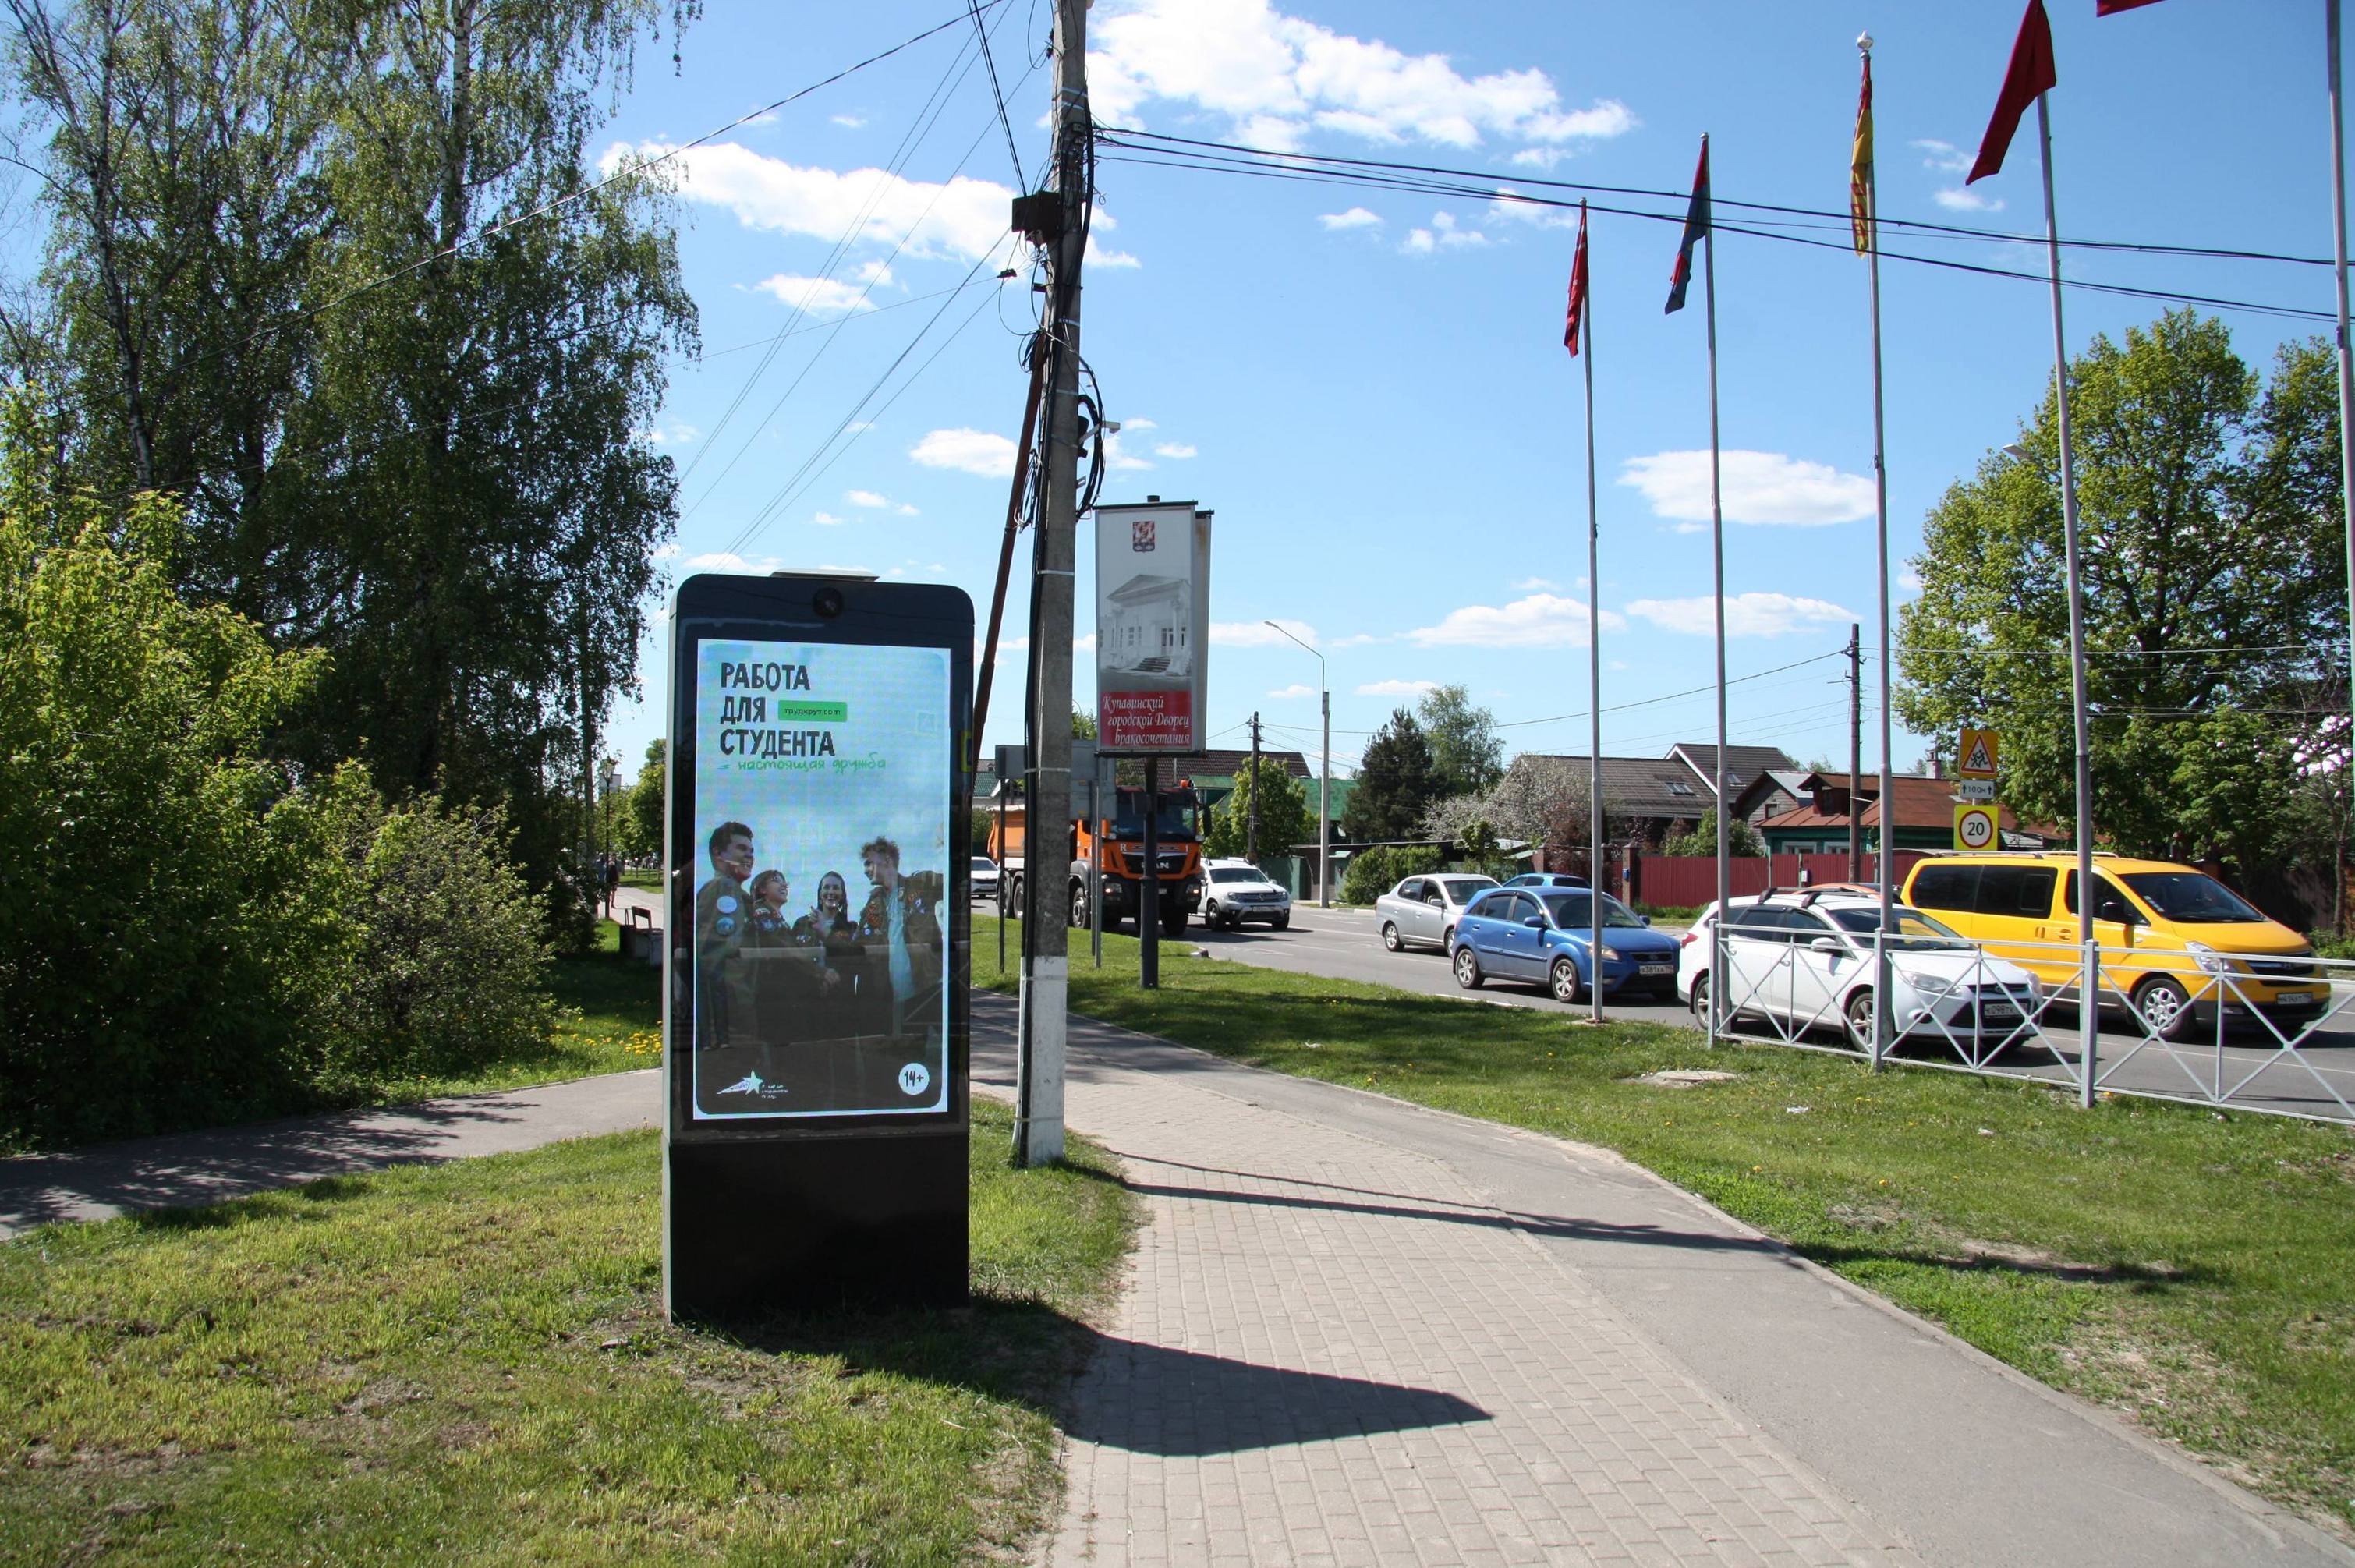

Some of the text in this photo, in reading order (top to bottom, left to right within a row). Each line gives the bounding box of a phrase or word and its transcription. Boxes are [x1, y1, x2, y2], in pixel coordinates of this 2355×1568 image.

[721, 662, 810, 692] РАБОТА
[720, 696, 766, 724] ДЛЯ
[1103, 696, 1163, 713] Купавинский
[1108, 711, 1189, 731] городской Дворец
[720, 728, 835, 759] СТУДЕНТА
[738, 759, 827, 772] настоящая
[833, 752, 886, 776] дружба
[1967, 822, 1985, 836] 20
[904, 1071, 924, 1087] 14+
